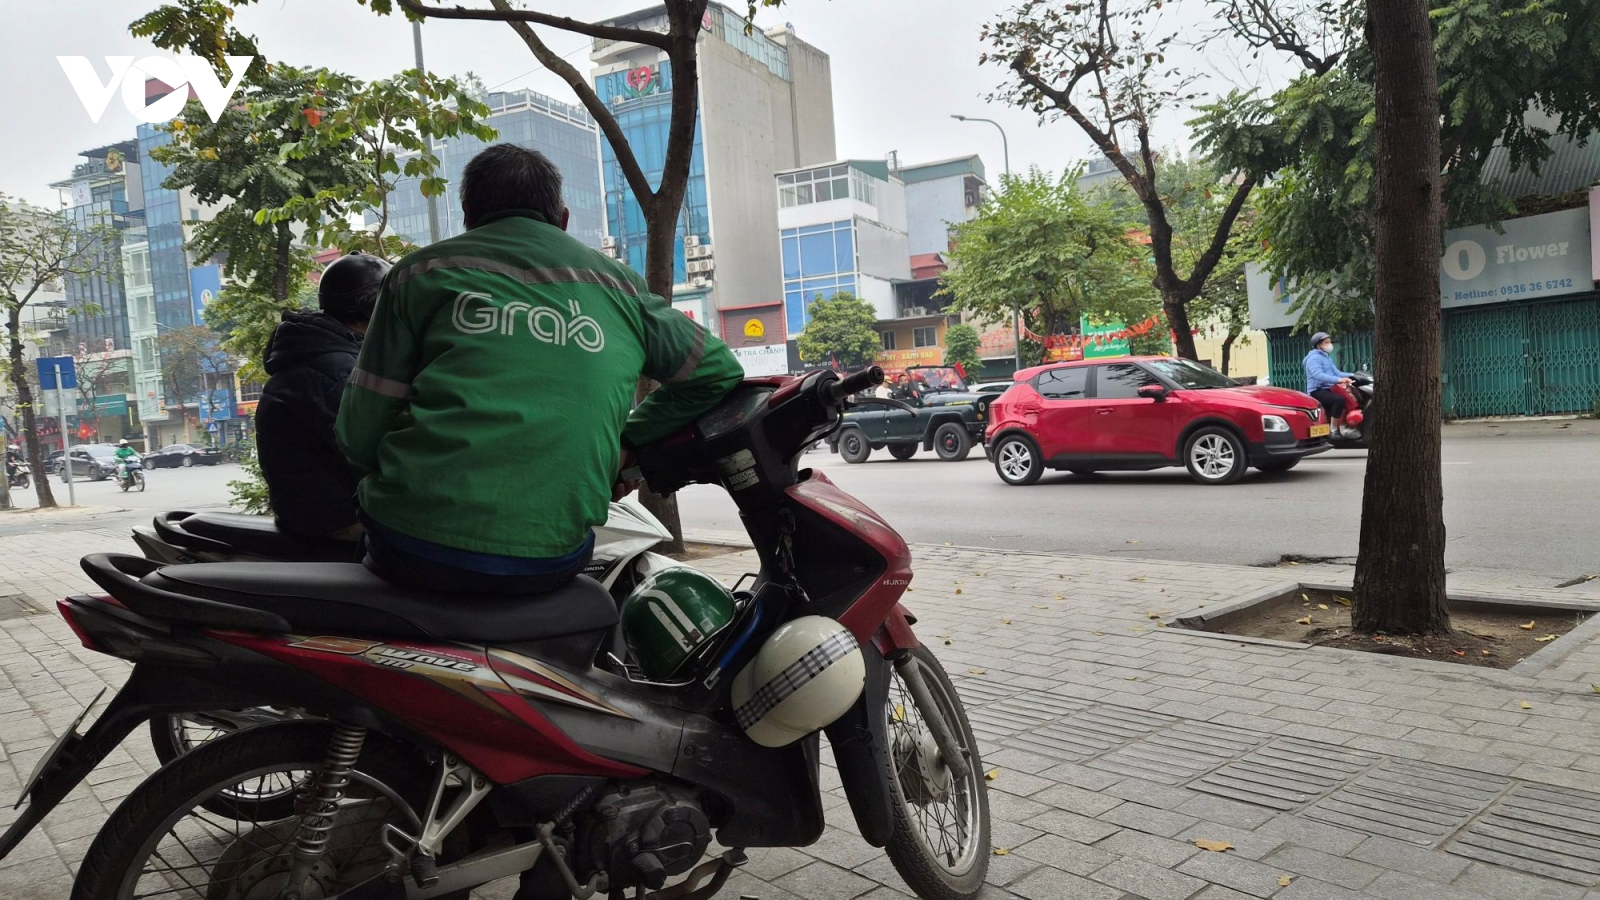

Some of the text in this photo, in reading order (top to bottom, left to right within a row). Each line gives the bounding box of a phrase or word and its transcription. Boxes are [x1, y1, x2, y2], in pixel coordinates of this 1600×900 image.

[1496, 241, 1569, 264] Flower
[1454, 289, 1497, 301] Hotline:
[1500, 284, 1526, 295] 0936
[1529, 282, 1543, 292] 36
[1546, 278, 1573, 290] 6742
[452, 290, 605, 353] Grab
